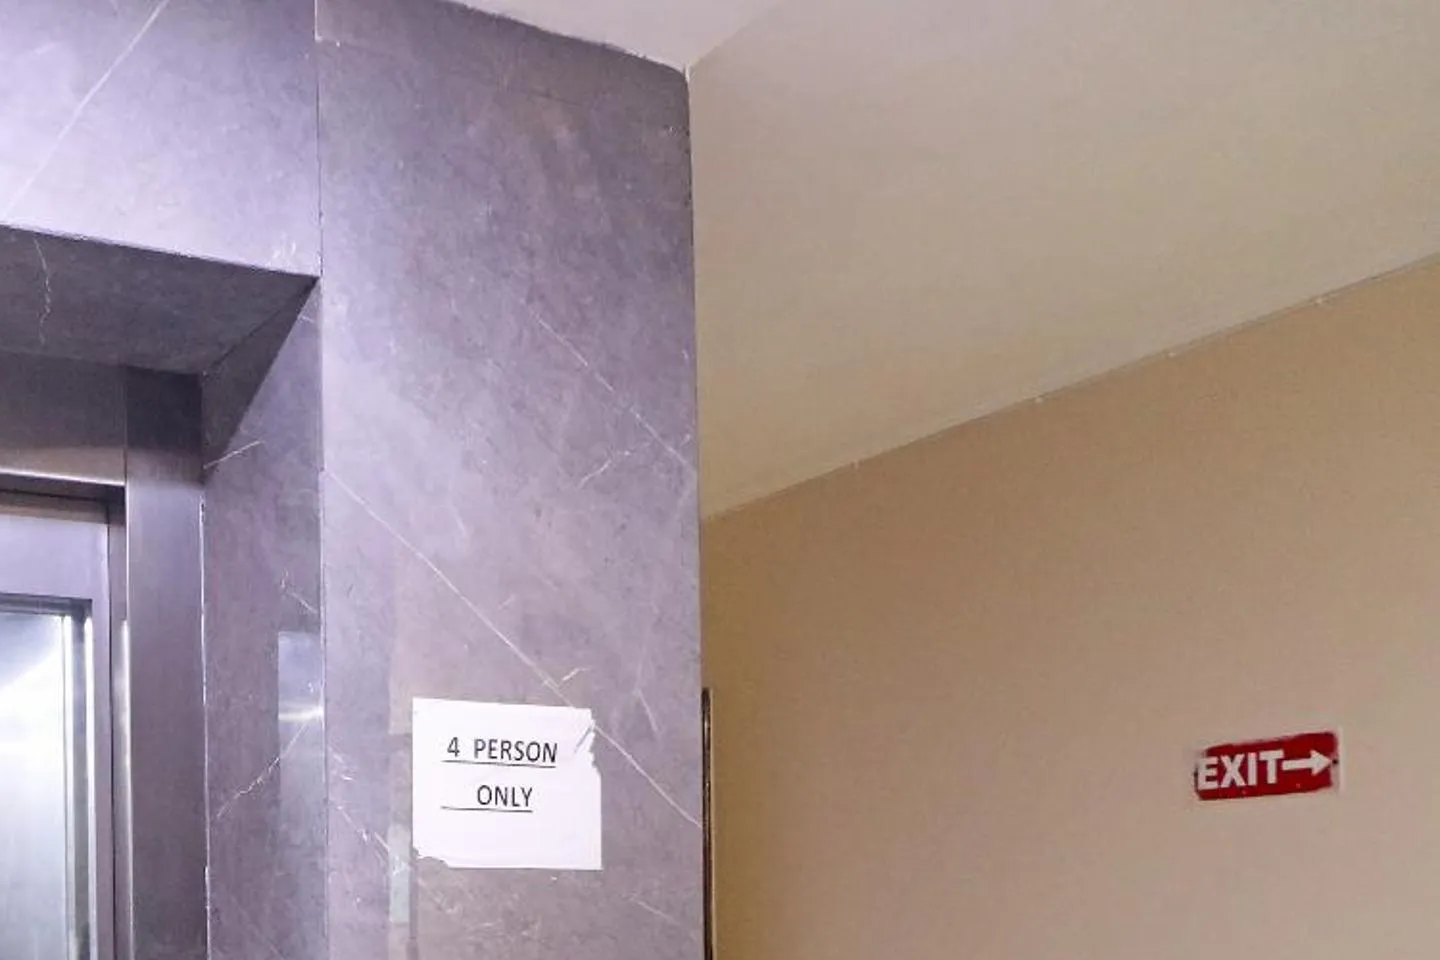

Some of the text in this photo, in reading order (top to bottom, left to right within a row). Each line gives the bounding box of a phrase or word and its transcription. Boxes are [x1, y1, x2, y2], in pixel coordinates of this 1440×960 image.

[447, 737, 558, 762] 4 PERSON
[1198, 750, 1284, 790] EXIT
[477, 785, 533, 807] ONLY
